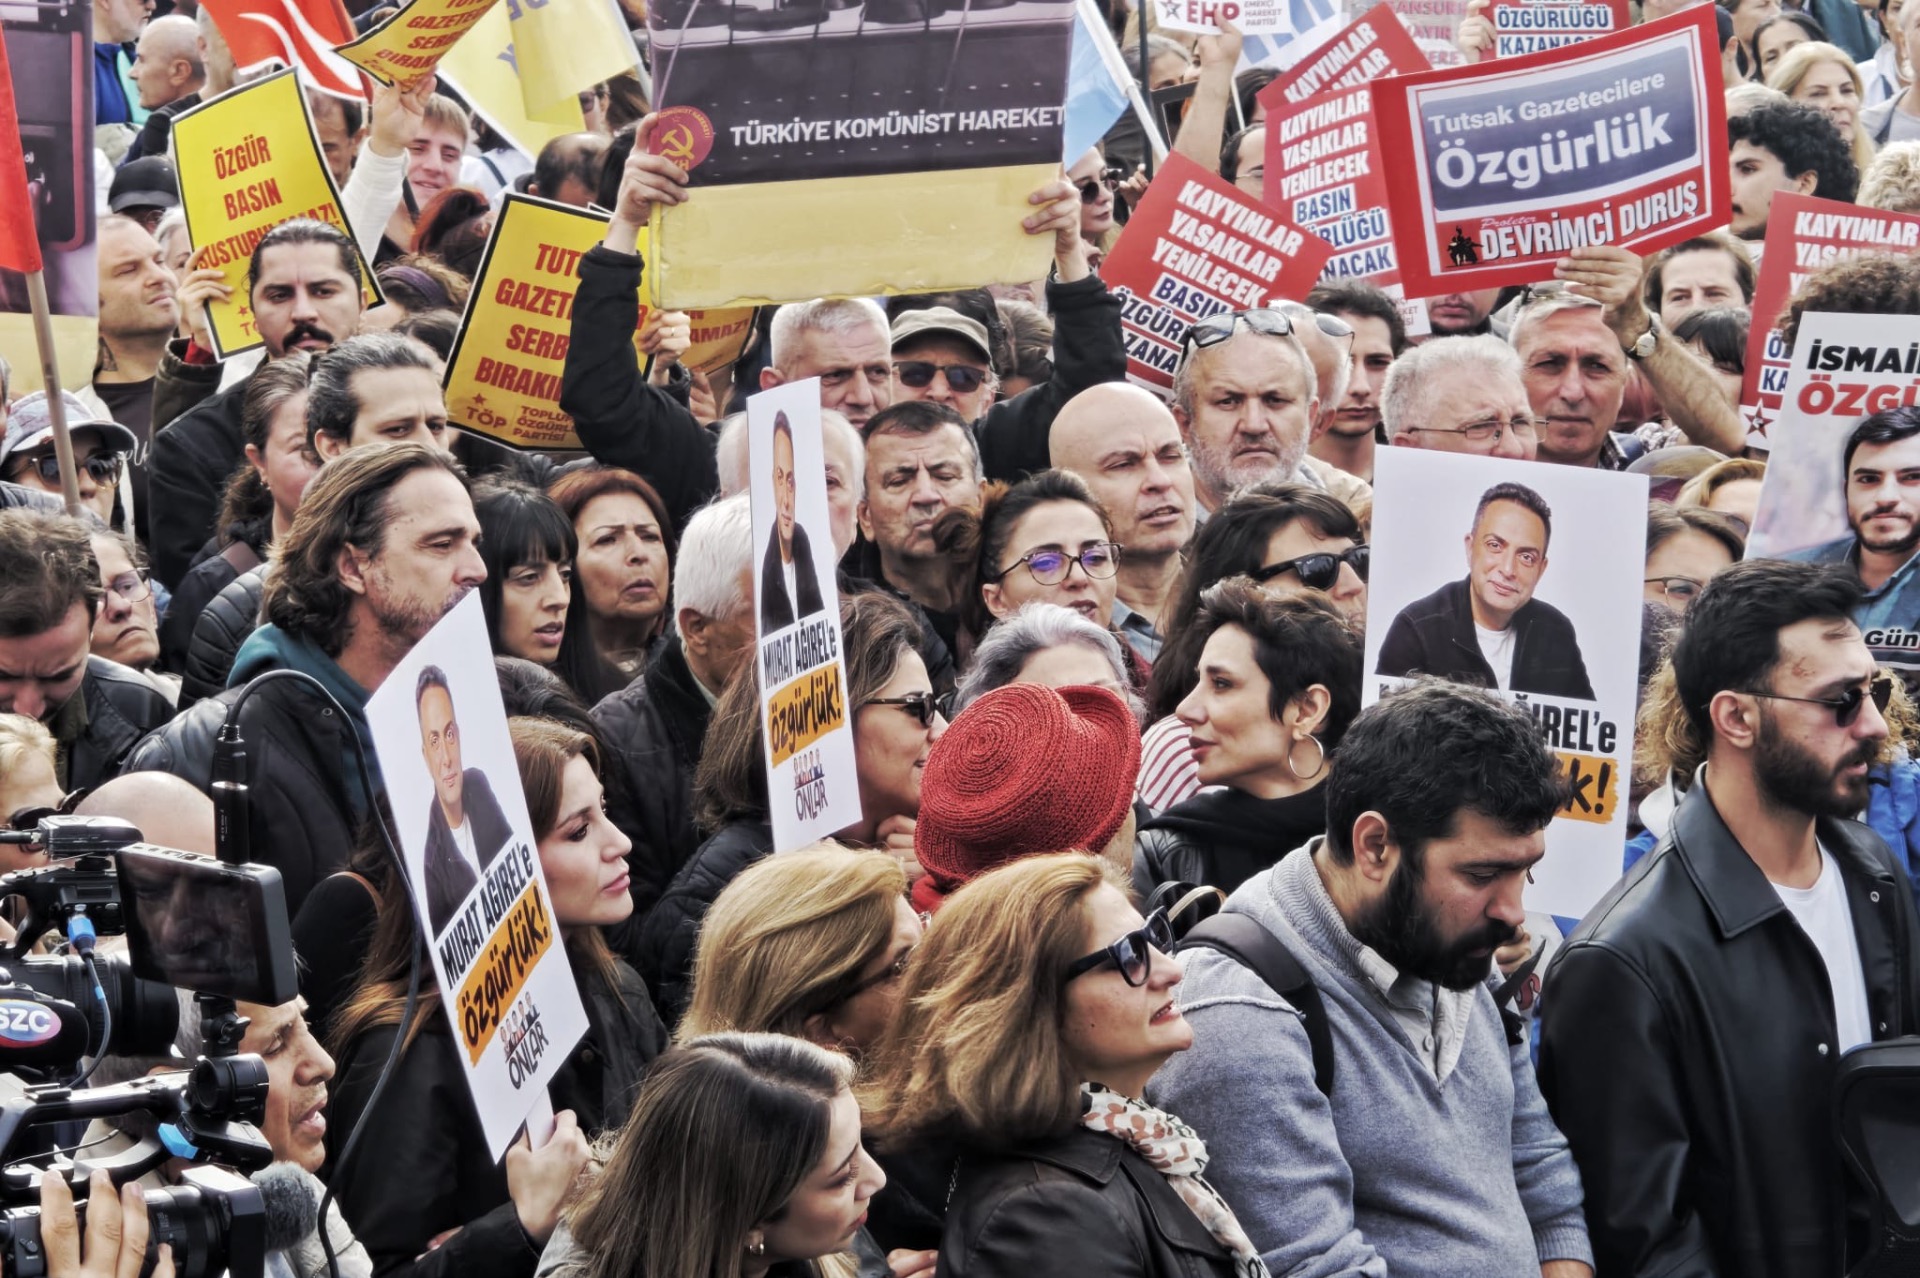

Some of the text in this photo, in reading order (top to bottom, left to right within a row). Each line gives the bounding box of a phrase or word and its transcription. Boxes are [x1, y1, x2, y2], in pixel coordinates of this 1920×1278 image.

[1498, 5, 1610, 28] ÖZGÜRLÜĞÜ
[1283, 22, 1378, 103] KAYYIMLAR
[730, 105, 1066, 146] TÜRKİYE KOMÜNİST HAREKET
[1280, 90, 1370, 145] KAYYIMLAR
[1428, 73, 1666, 135] Tutsak Gazetecilere
[213, 134, 272, 180] ÖZGÜR
[1282, 121, 1368, 171] YASAKLAR
[1436, 106, 1673, 190] Özgürlük
[224, 178, 283, 221] BASIN
[1281, 150, 1371, 200] YENİLECEK
[1177, 180, 1304, 257] KAYYIMLAR
[1296, 187, 1352, 223] BASIN
[1480, 181, 1699, 261] DEVRİMCİ DURUŞ
[1794, 211, 1920, 247] KAYYIMLAR
[535, 243, 584, 279] TUT
[1168, 209, 1283, 283] YASAKLAR
[1151, 237, 1269, 312] YENİLECEK
[1807, 339, 1920, 373] İSMAİ
[466, 406, 508, 429] TÖP
[513, 427, 566, 442] PARTİSİ
[517, 416, 577, 434] ÖZGÜRL
[763, 618, 837, 690] MURAT AĞIREL'e
[770, 667, 841, 754] özgürlük!
[795, 780, 829, 821] ONLAR
[439, 843, 533, 990] MURAT AĞIREL'e
[461, 885, 549, 1048] özgürlük!
[509, 1019, 550, 1090] ONLAR
